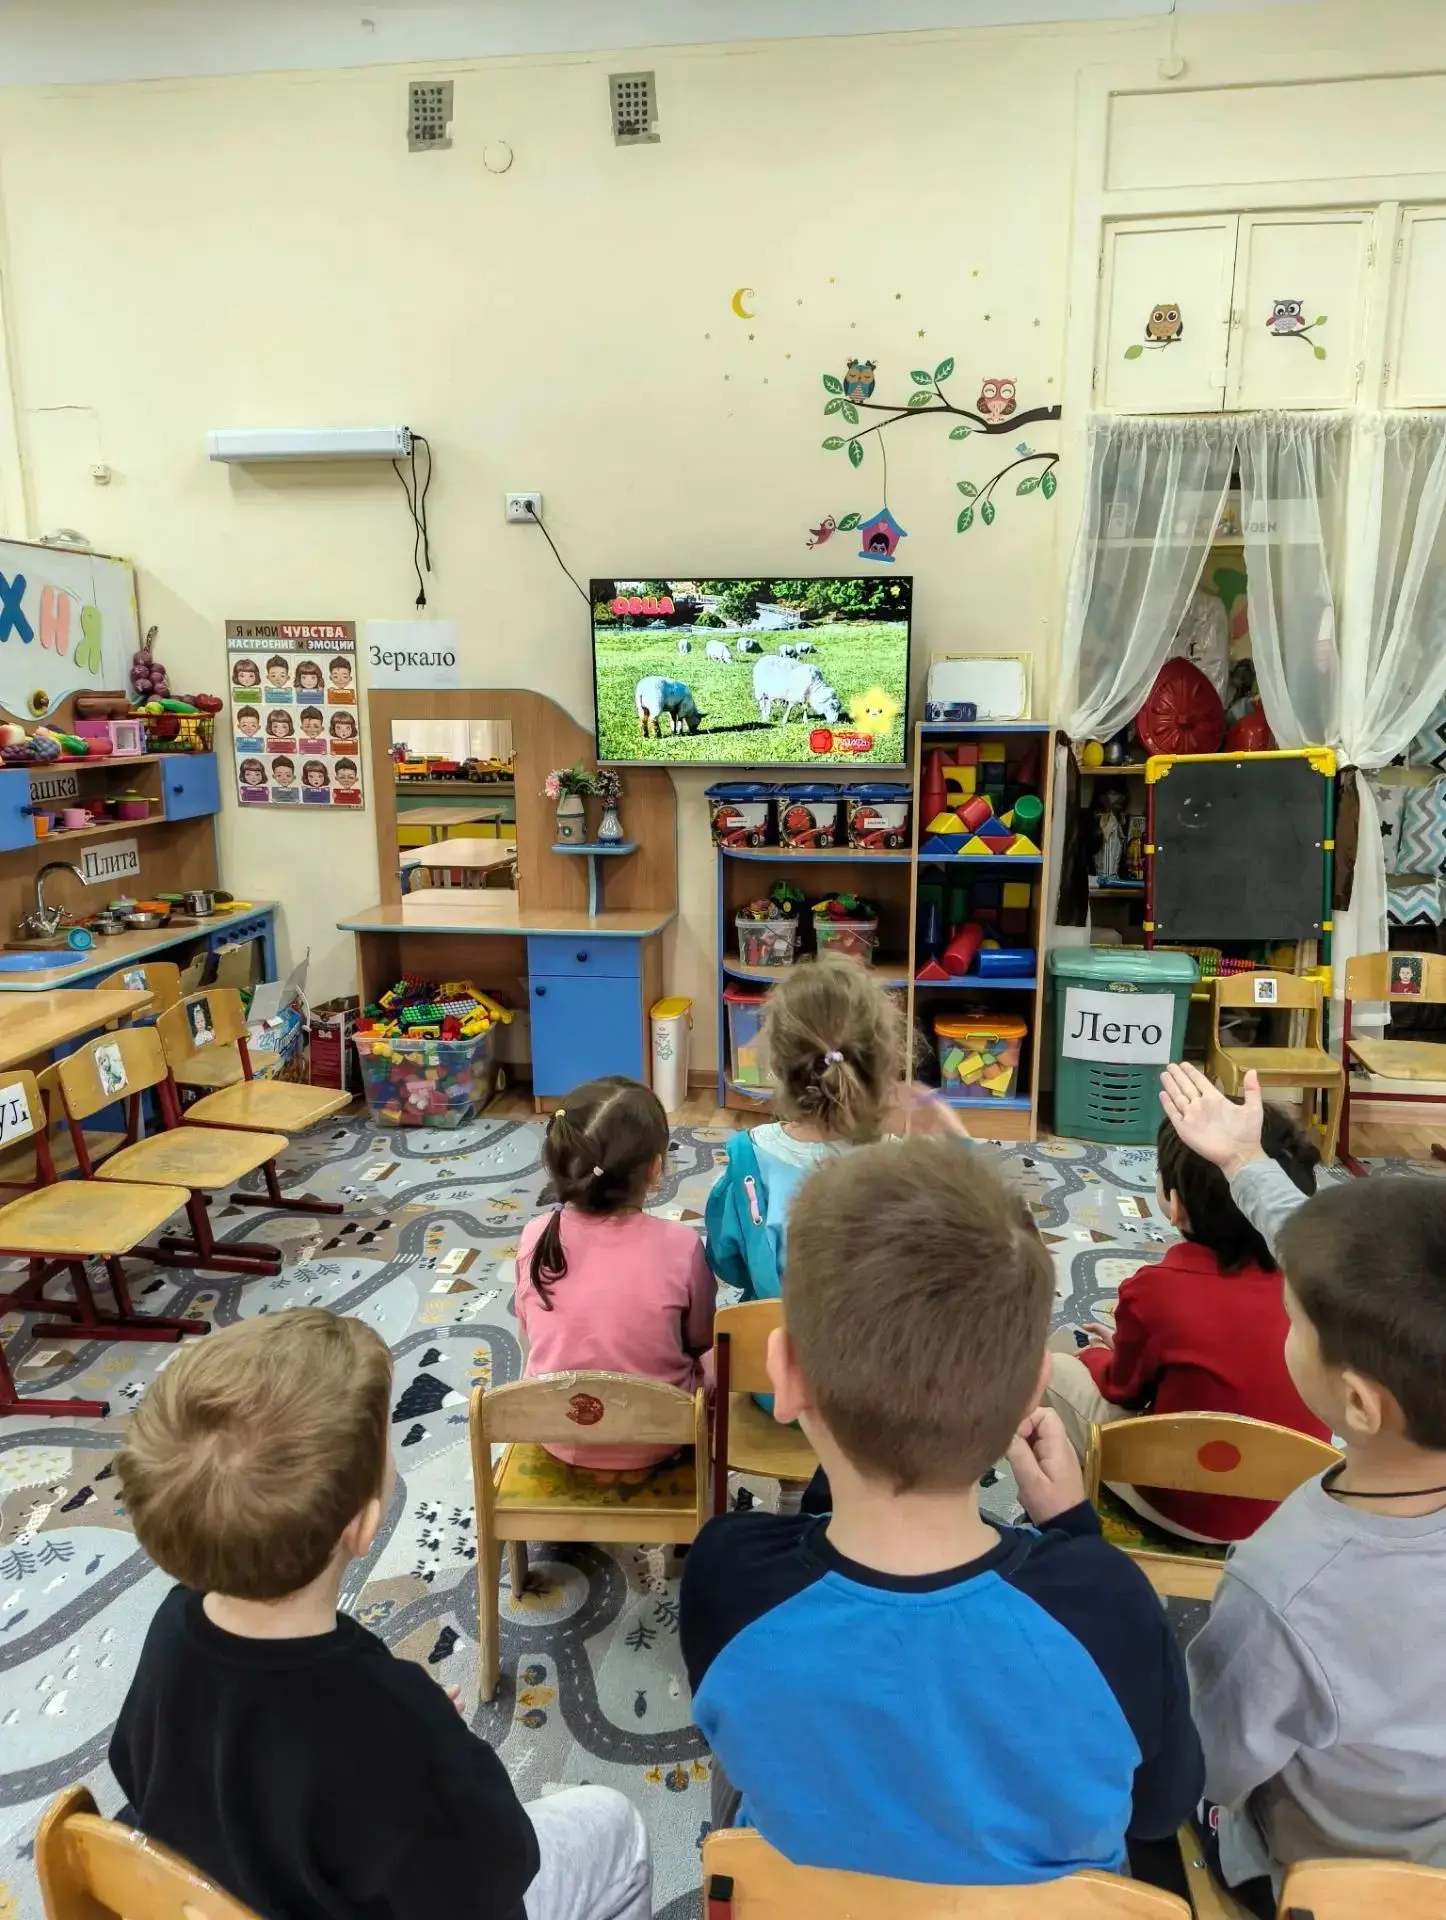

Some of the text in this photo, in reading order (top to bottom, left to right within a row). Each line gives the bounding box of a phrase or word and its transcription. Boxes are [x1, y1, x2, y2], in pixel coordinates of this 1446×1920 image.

[612, 597, 676, 616] ОВЦА
[236, 626, 243, 637] Я
[228, 639, 295, 649] НАСТРОЕНИЕ
[307, 640, 355, 651] ЭМОЦИИ
[369, 645, 456, 671] Зеркало
[29, 775, 77, 801] ашка
[84, 850, 138, 878] Плита
[1071, 1010, 1162, 1045] Лего
